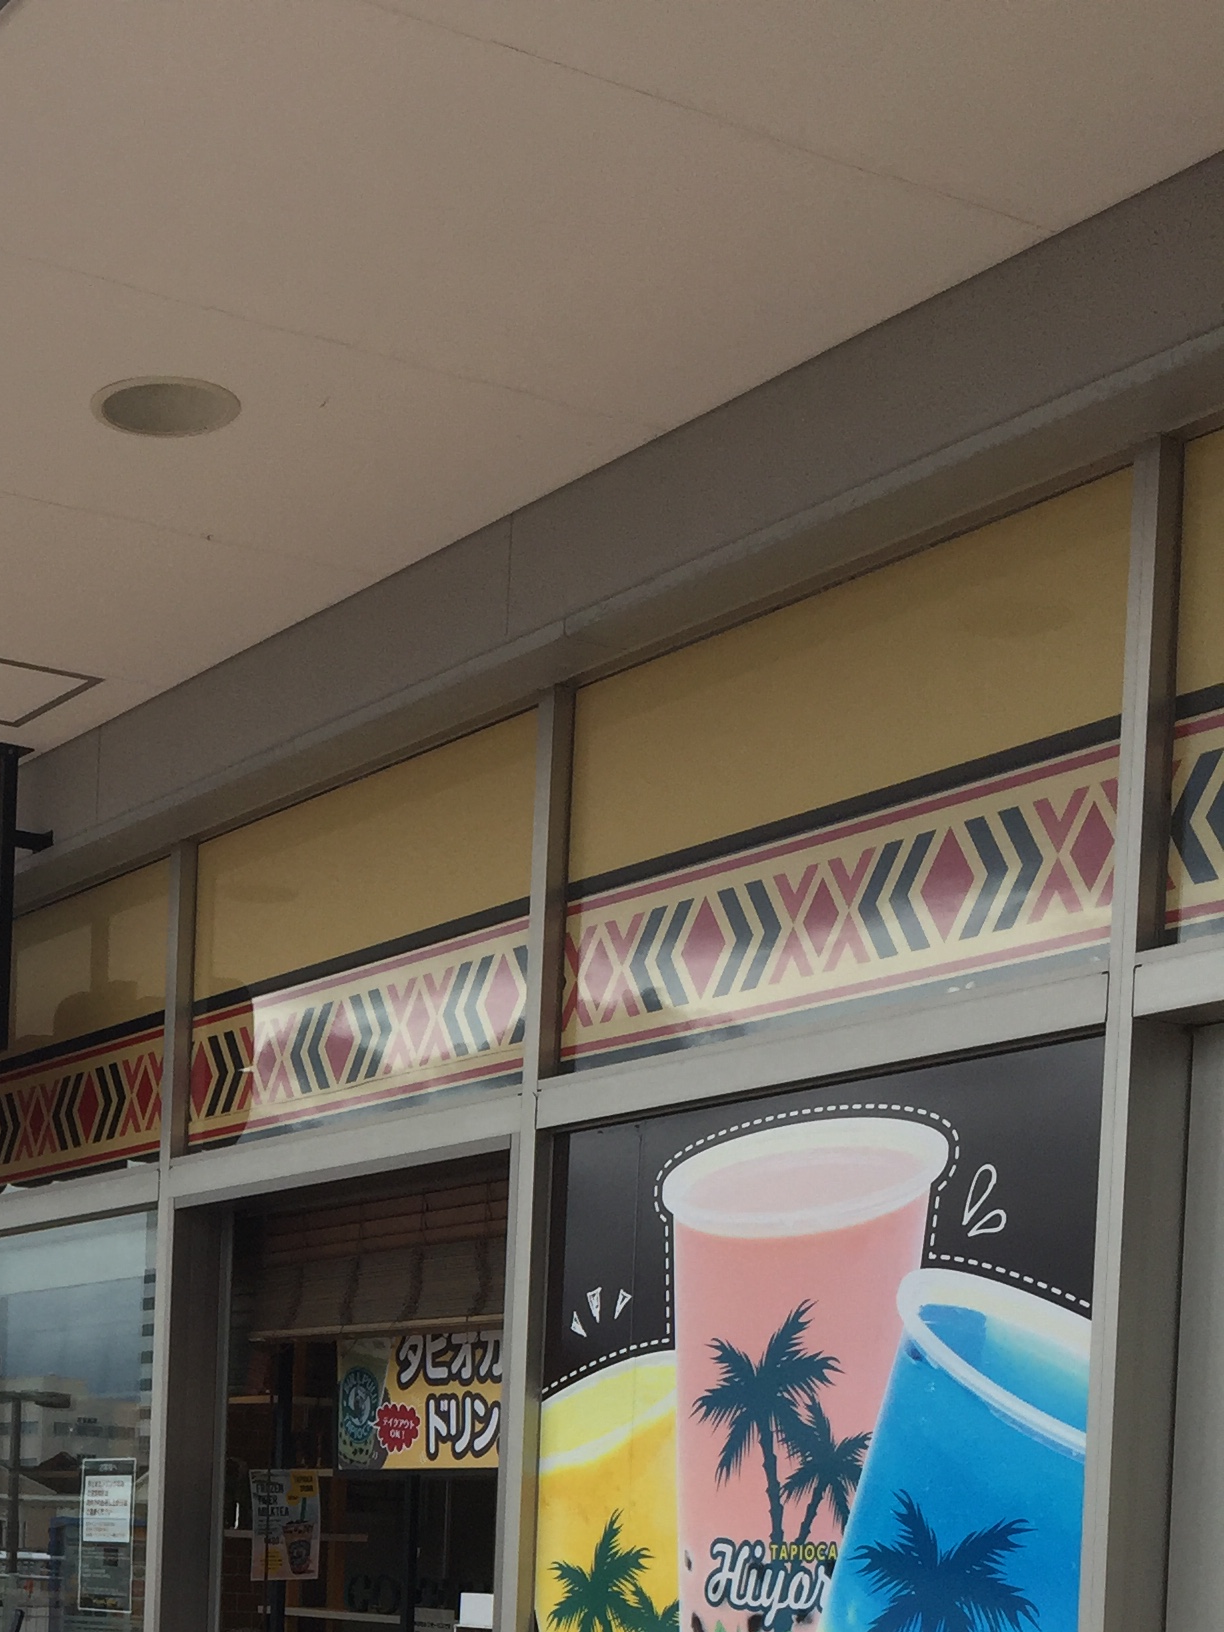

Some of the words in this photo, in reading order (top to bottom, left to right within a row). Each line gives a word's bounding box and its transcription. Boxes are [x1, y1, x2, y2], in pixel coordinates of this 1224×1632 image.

[399, 1331, 503, 1384] タピオカ
[429, 1396, 500, 1454] ドリン
[707, 1542, 832, 1627] Hiyor
[770, 1544, 837, 1561] TAPIOCA
